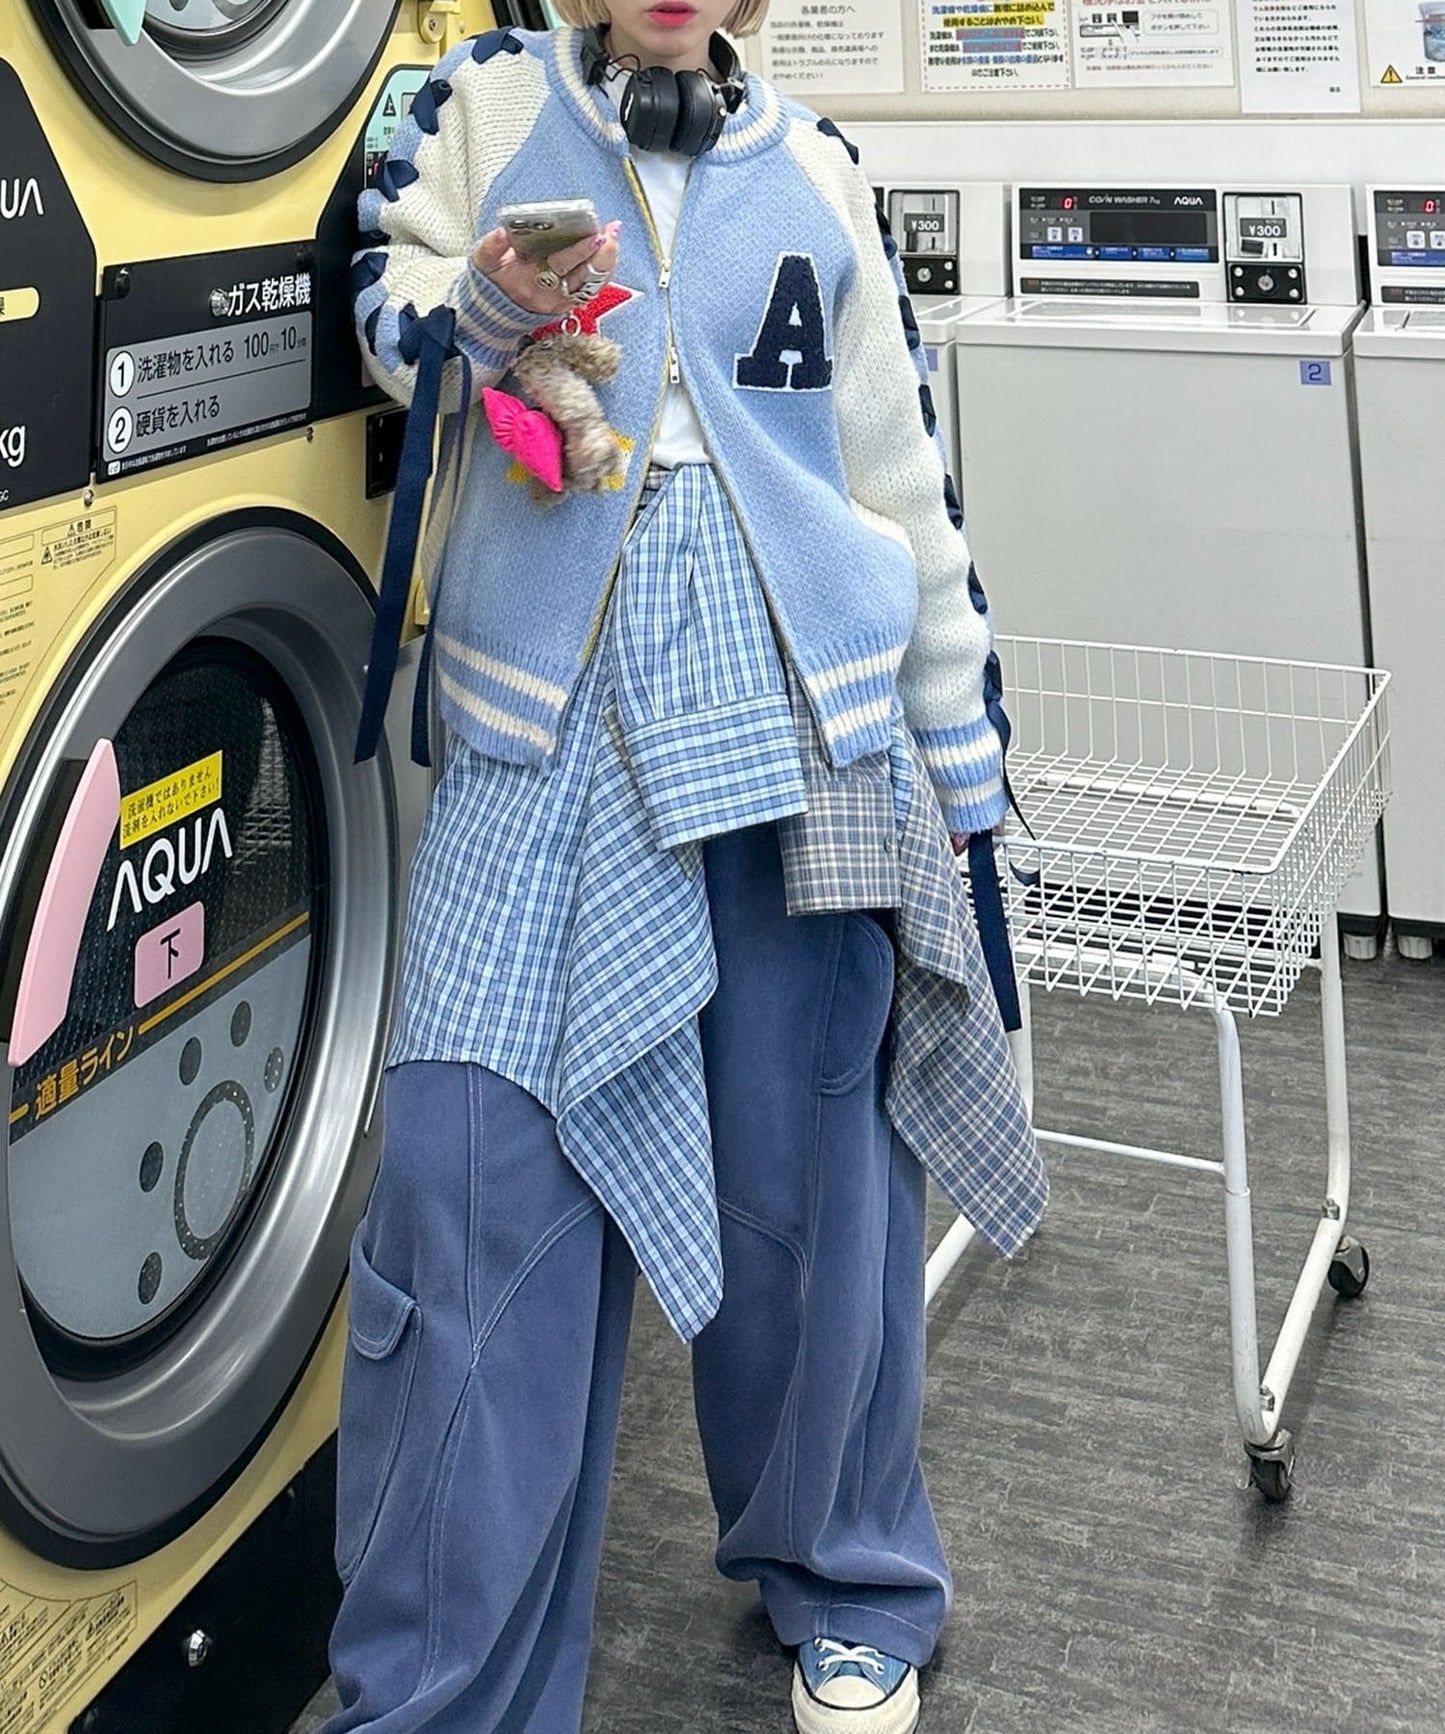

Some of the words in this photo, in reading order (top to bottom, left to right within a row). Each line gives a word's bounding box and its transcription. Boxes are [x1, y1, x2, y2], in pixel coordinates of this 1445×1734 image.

[1064, 197, 1073, 209] 0
[1174, 196, 1203, 206] AQUA
[1425, 199, 1434, 213] 0
[912, 220, 939, 231] ¥300
[1249, 224, 1281, 237] ¥300
[227, 272, 312, 317] ガス乾燥機
[733, 251, 834, 392] A
[137, 339, 235, 384] 洗濯物を入れる
[1307, 363, 1322, 381] 2
[136, 394, 221, 438] 硬貨を入れる
[107, 807, 232, 931] AQUA
[160, 928, 182, 980] 下
[34, 1024, 134, 1121] 適量ライン
